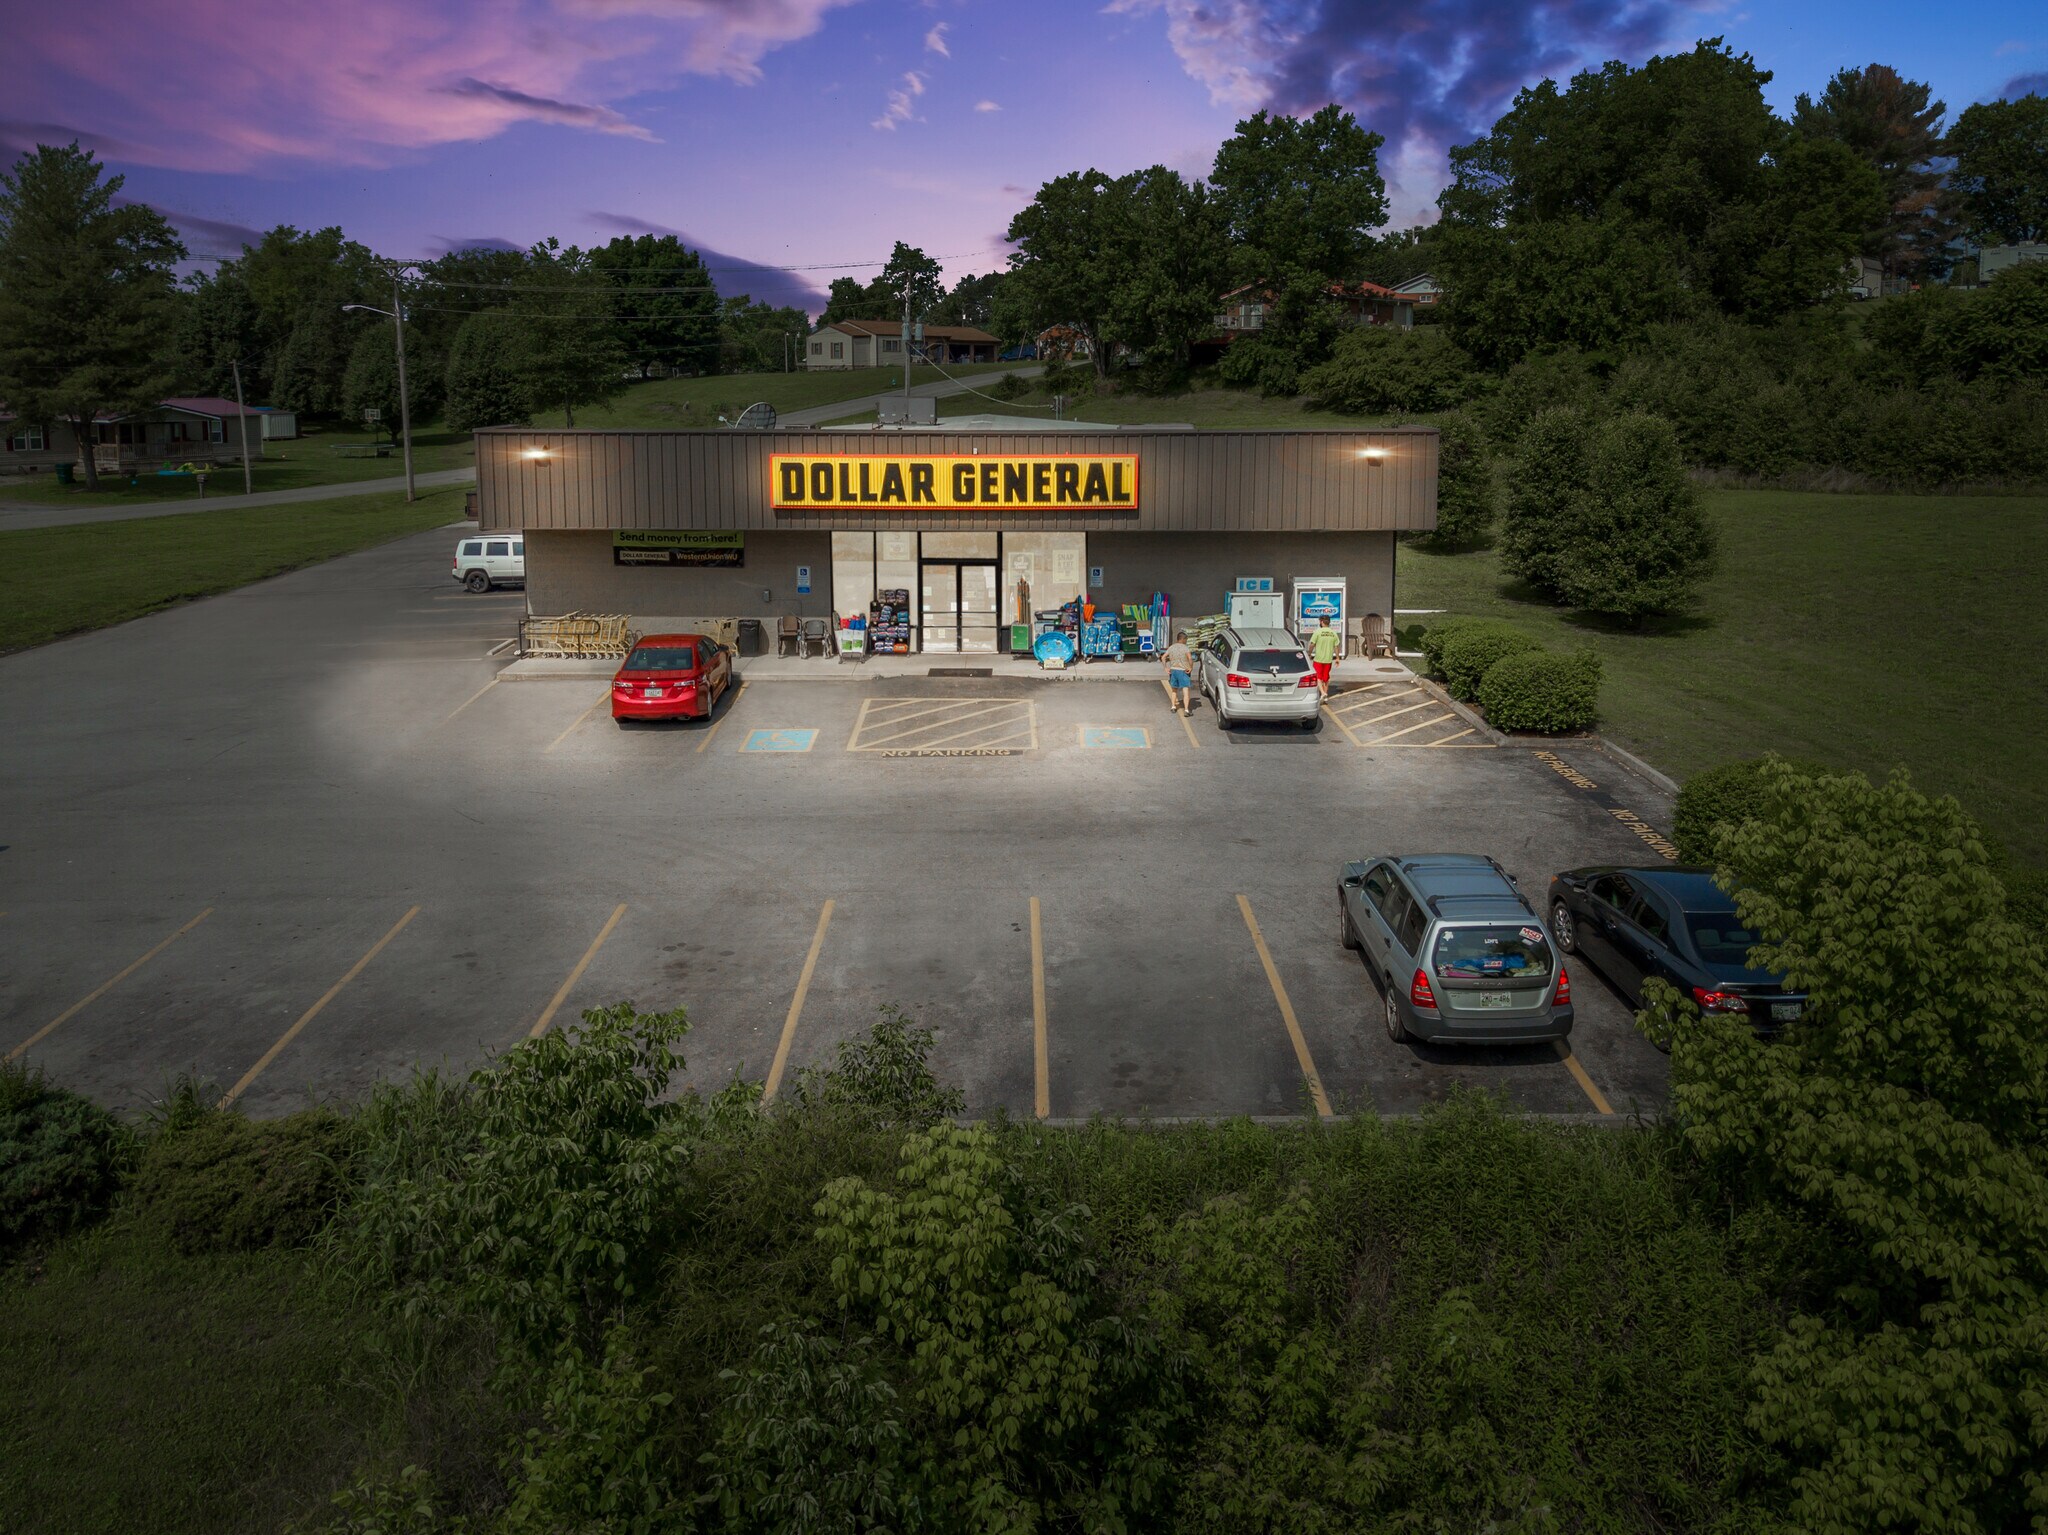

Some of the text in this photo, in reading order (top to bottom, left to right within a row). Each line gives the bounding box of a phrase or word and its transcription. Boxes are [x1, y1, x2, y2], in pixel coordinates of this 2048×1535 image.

[780, 462, 1131, 503] DOLLAR GENERAL
[620, 532, 738, 544] Send money from here!
[1239, 580, 1271, 591] ICE
[1531, 751, 1598, 789] NO PARKING
[1608, 808, 1680, 860] NO PARKING
